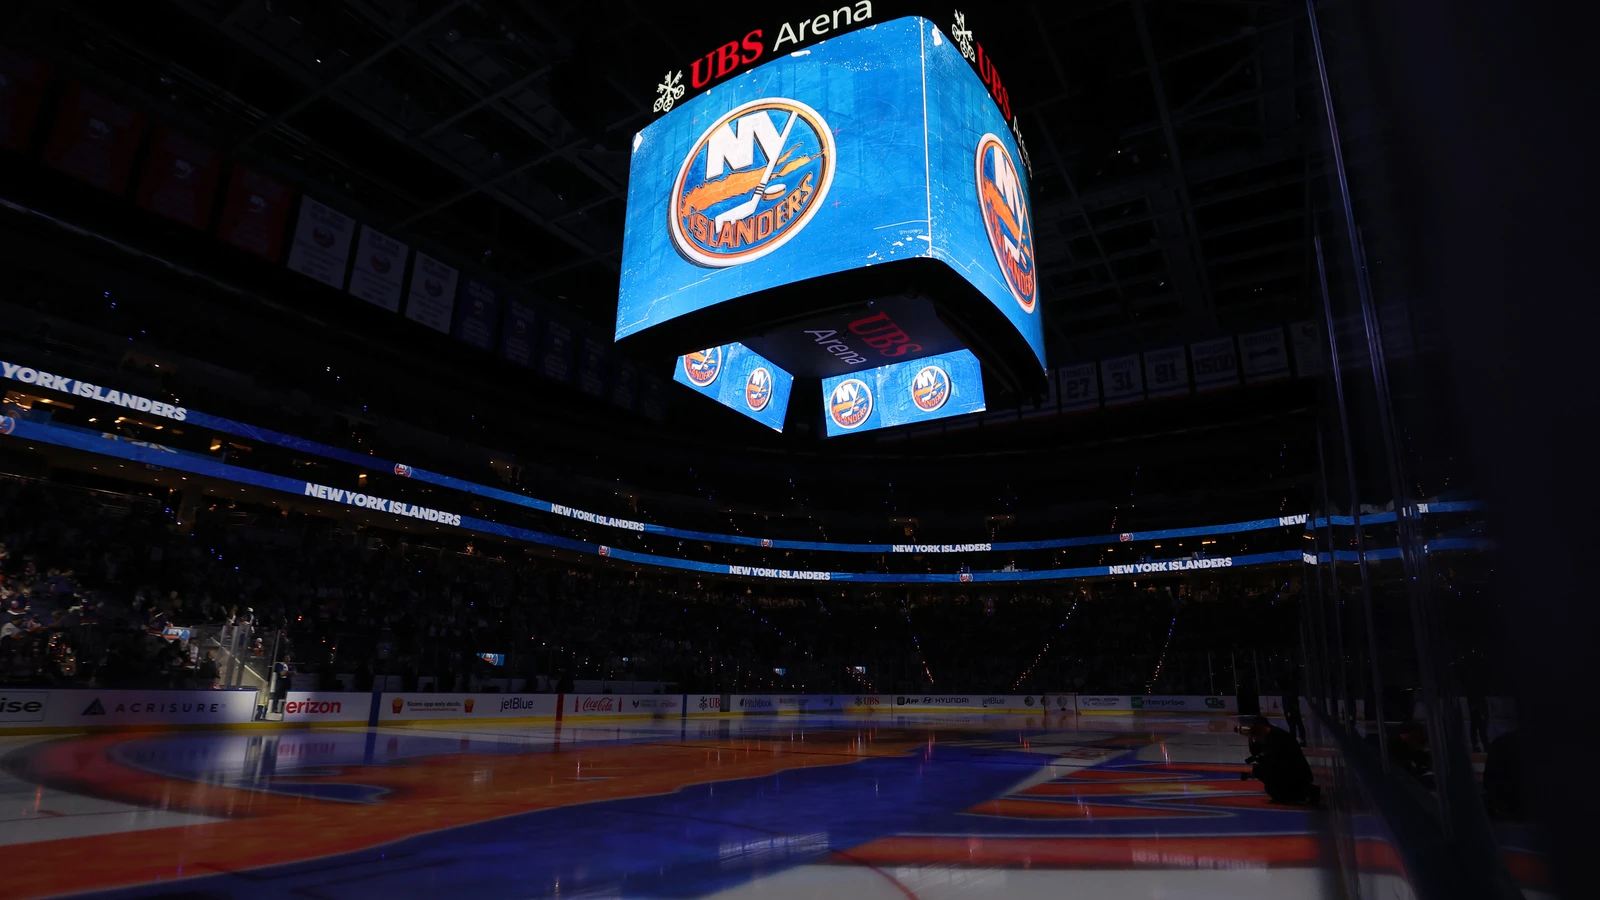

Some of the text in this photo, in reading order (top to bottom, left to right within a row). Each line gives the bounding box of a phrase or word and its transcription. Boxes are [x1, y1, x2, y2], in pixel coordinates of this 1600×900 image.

[690, 0, 872, 89] UBS Arena
[976, 41, 1012, 121] UBS
[706, 110, 798, 180] NY
[687, 171, 814, 249] ISLANDERS
[848, 311, 923, 357] UBS
[803, 328, 867, 365] Arena
[1112, 370, 1134, 392] 31
[1155, 361, 1177, 384] 91
[2, 361, 187, 421] YORK ISLANDERS
[1066, 378, 1090, 399] 27
[305, 482, 461, 527] NEW YORK ISLANDERS
[551, 503, 645, 531] NEW YORK ISLANDERS
[1279, 514, 1306, 526] NEW
[892, 543, 992, 553] NEW YORK ISLANDERS
[729, 565, 831, 580] NEW YORK ISLANDERS
[1109, 557, 1232, 574] NEW YORK ISLANDERS
[500, 697, 534, 712] jetBlue
[744, 698, 772, 708] PitchBook
[863, 697, 880, 705] UBS
